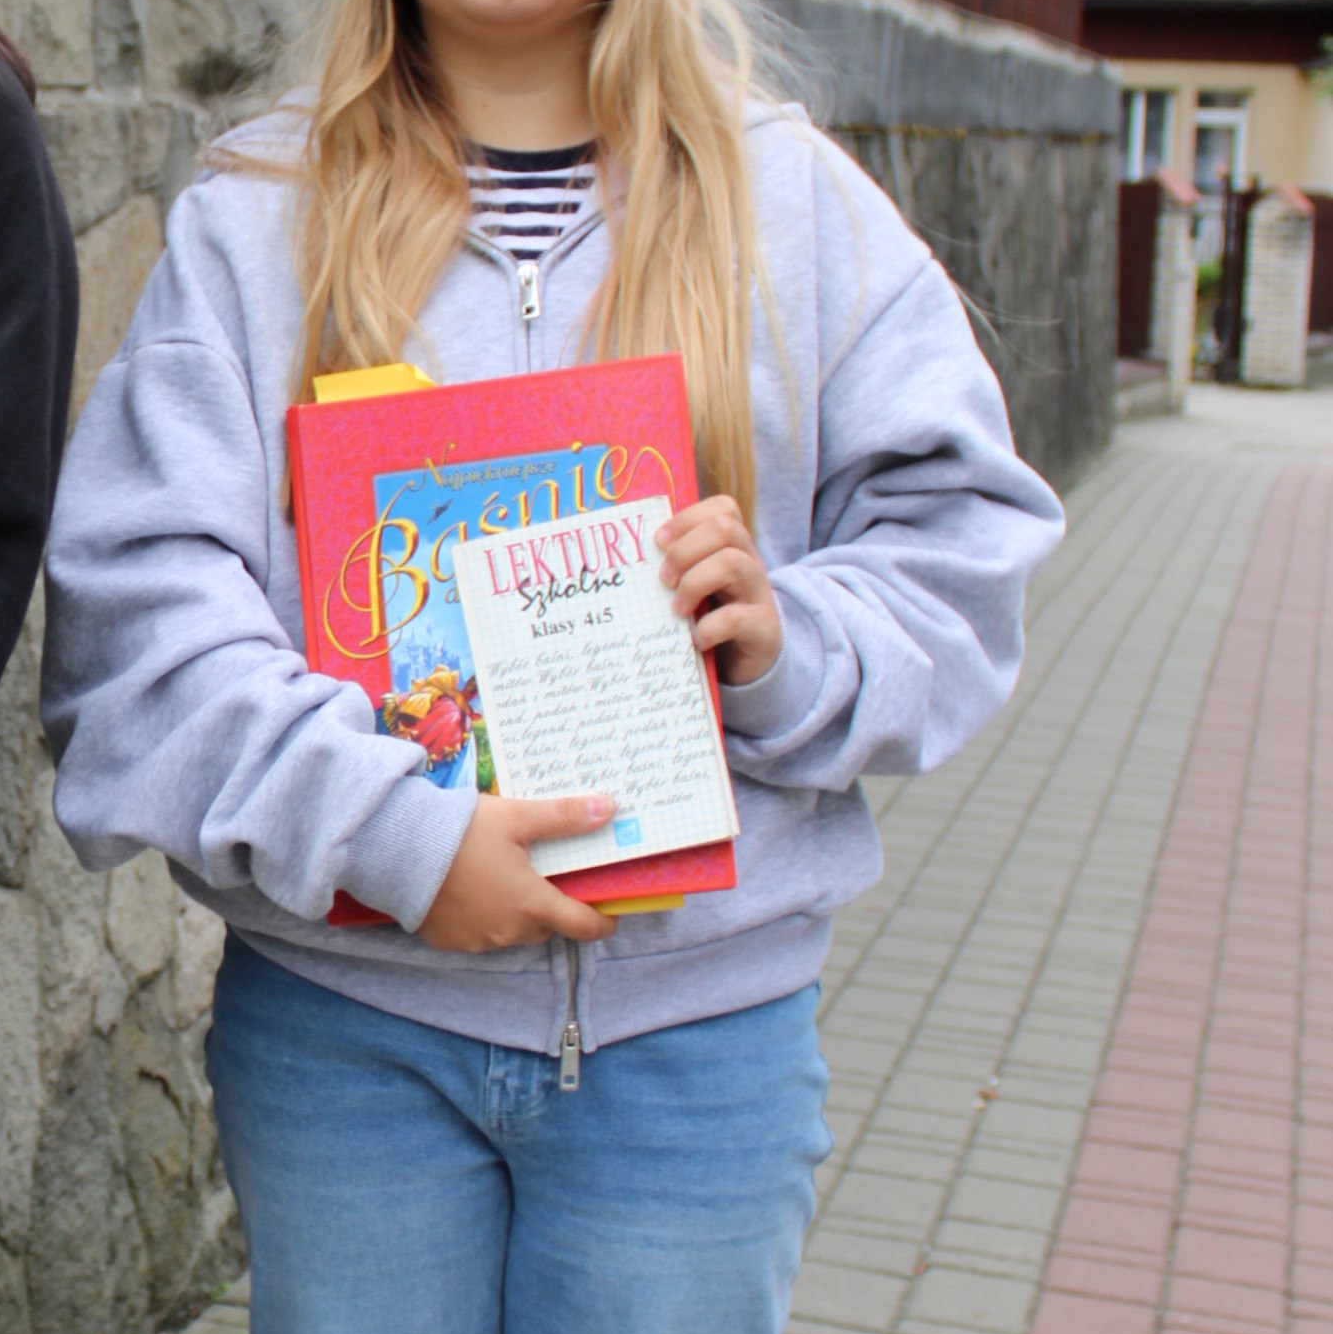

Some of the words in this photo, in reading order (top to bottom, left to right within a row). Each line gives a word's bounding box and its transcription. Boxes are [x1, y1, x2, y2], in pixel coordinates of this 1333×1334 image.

[407, 442, 557, 492] Najpiękniejsze
[484, 514, 647, 596] LEKTURY
[517, 564, 625, 618] Szkolne
[530, 619, 576, 639] klasy
